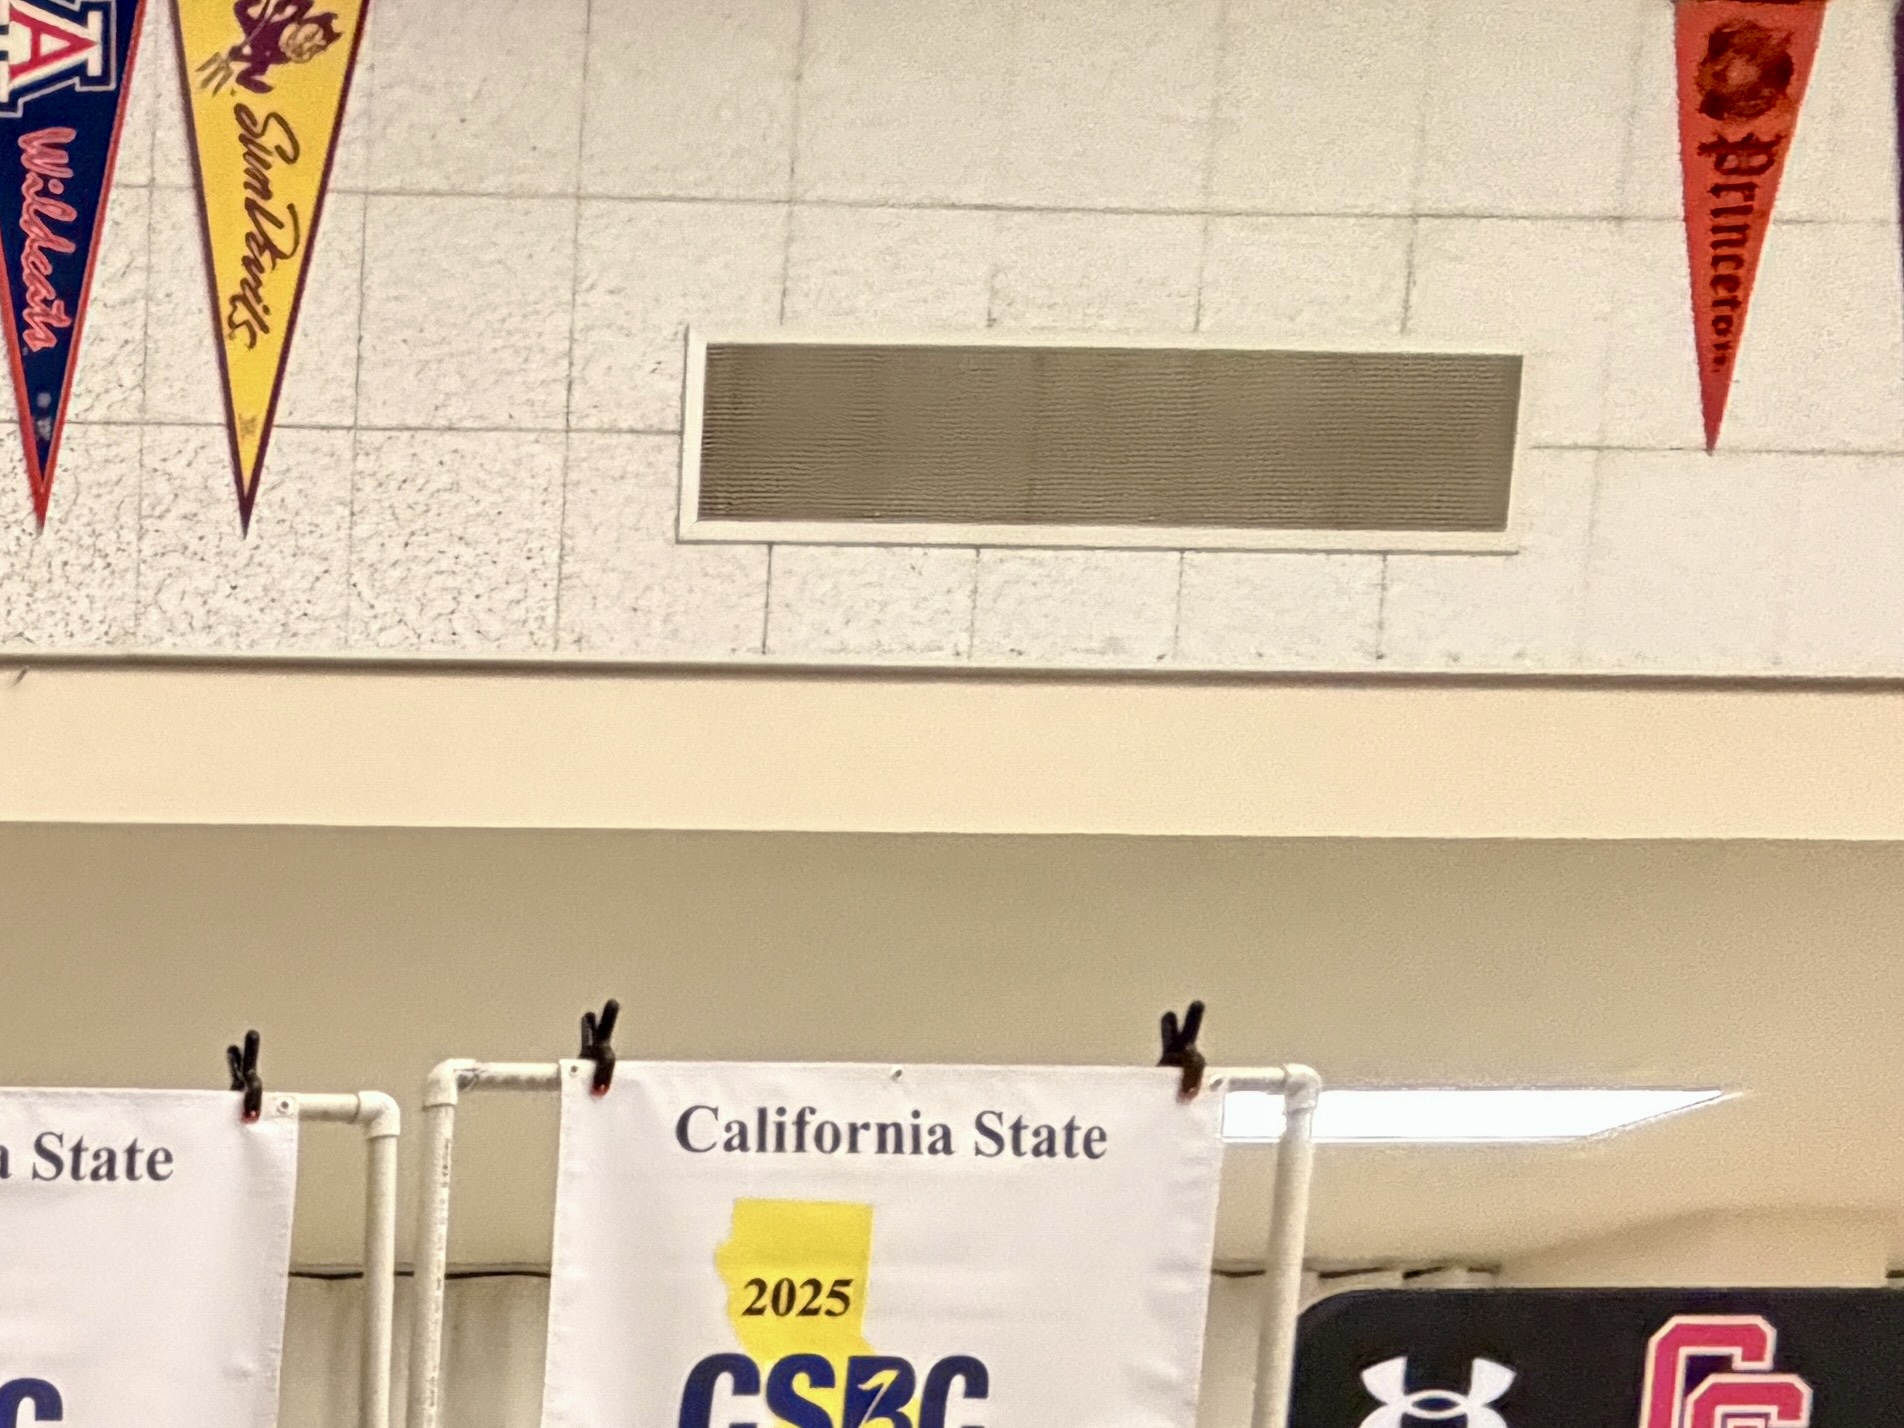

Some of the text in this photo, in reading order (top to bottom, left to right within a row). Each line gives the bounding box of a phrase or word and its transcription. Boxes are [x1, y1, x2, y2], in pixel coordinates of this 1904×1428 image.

[17, 126, 79, 352] Wildcats
[1697, 132, 1786, 373] Princeton
[30, 1130, 175, 1182] State
[675, 1103, 1109, 1161] California State
[740, 1276, 855, 1318] 2025
